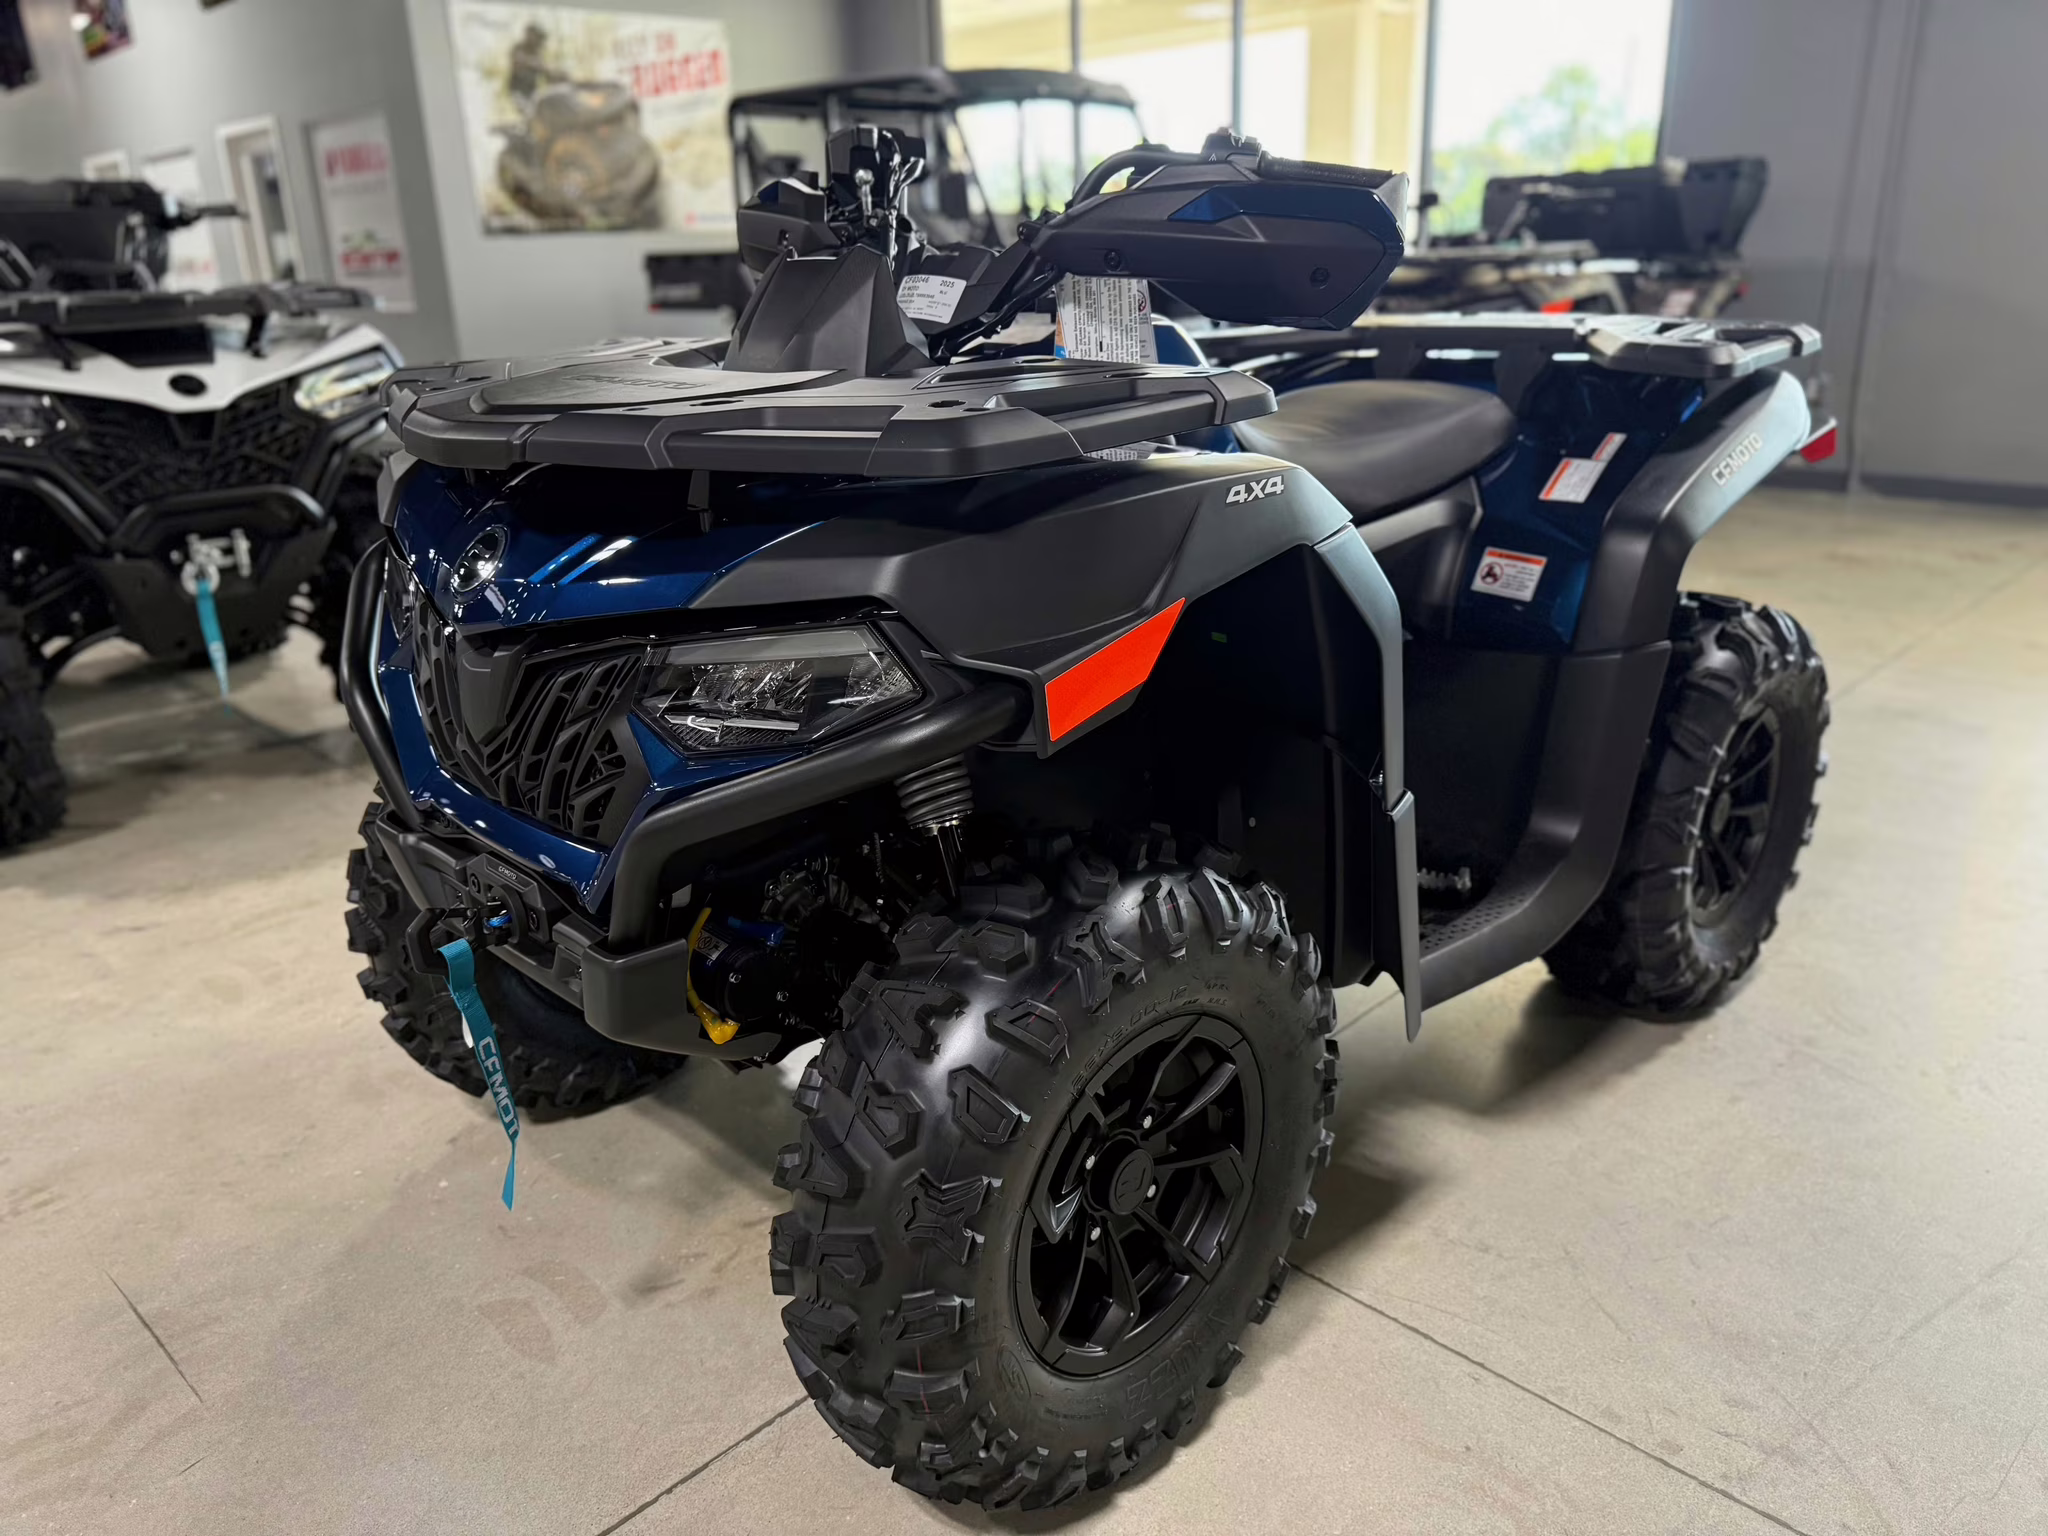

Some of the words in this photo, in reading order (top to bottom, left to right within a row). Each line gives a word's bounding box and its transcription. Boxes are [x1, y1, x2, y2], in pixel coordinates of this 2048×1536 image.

[905, 276, 930, 284] CF03046
[940, 280, 955, 288] 2025
[1711, 431, 1763, 487] CFMOTO
[498, 866, 517, 880] CFMOTO
